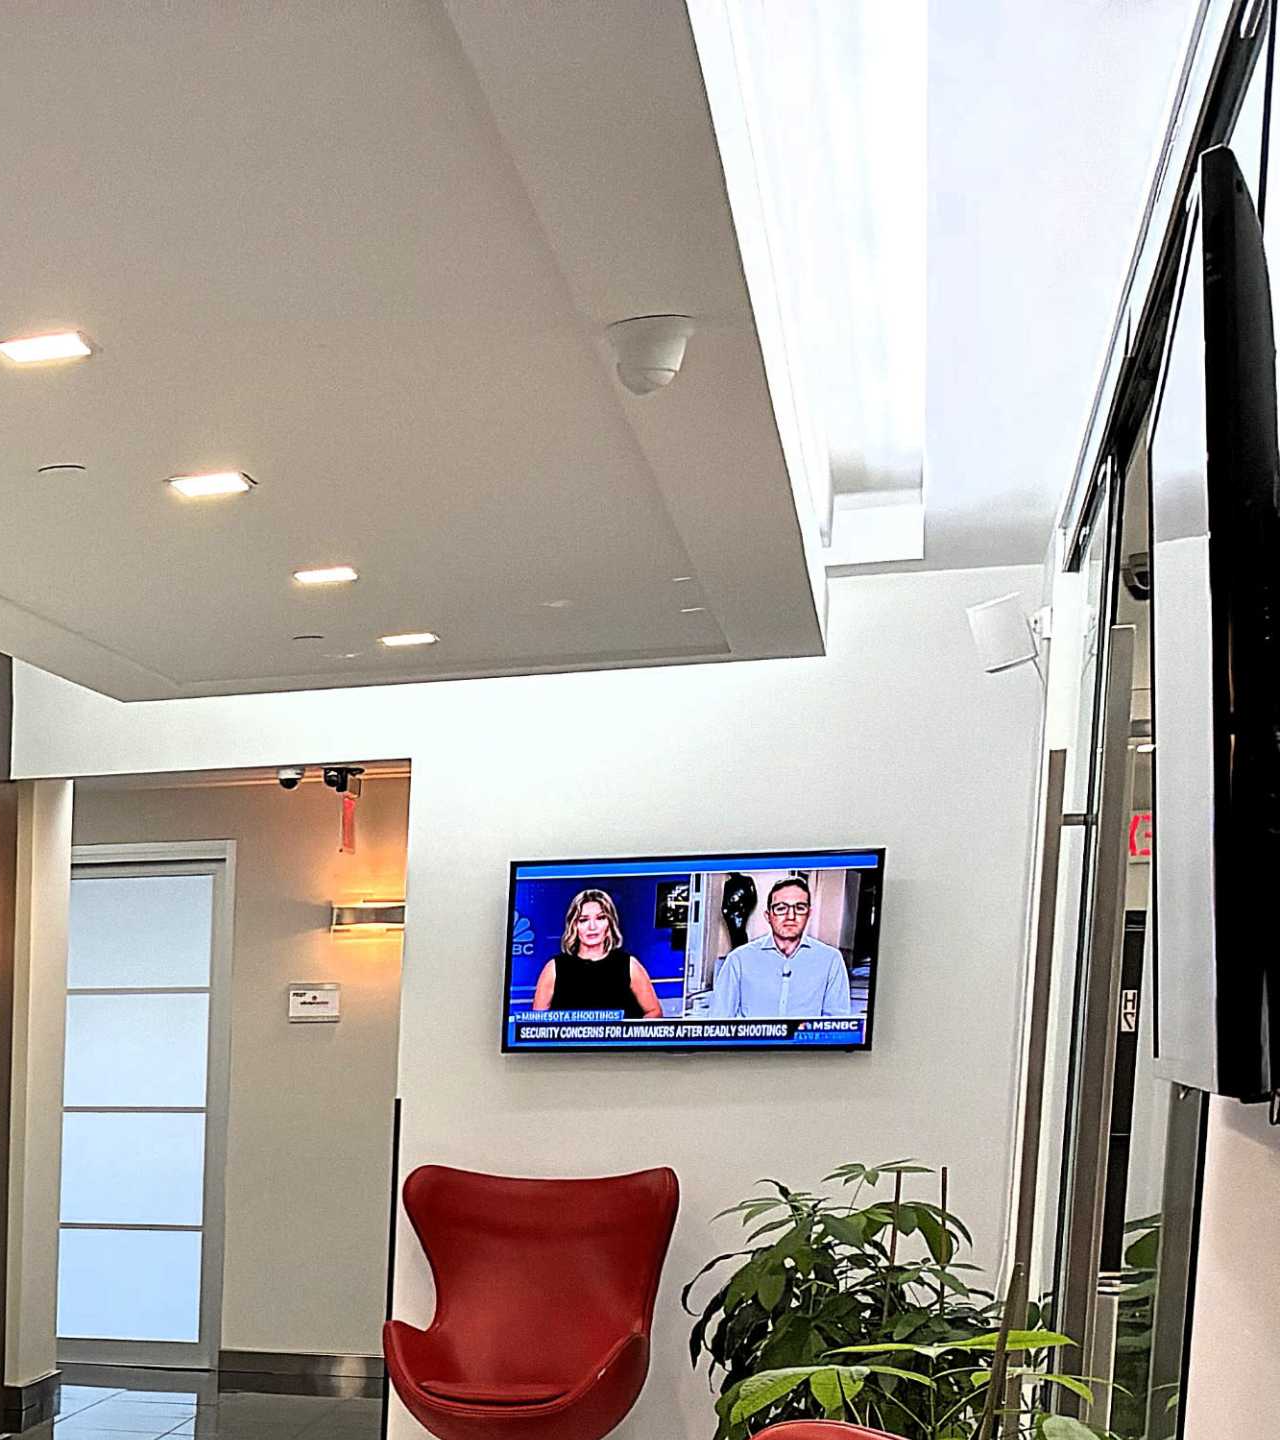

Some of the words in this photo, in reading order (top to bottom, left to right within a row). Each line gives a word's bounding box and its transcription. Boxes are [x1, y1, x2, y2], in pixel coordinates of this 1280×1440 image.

[512, 943, 534, 955] BC
[522, 1011, 569, 1021] MINNESOTA
[571, 1010, 619, 1020] SHOOTINGS
[813, 1021, 858, 1030] MSNBC
[520, 1026, 559, 1039] SECURITY
[560, 1026, 604, 1039] CONCERNS
[605, 1026, 622, 1038] FOR
[623, 1025, 675, 1038] LAWMAKERS
[676, 1025, 702, 1038] AFTER
[703, 1024, 737, 1037] DEADLY
[738, 1024, 788, 1037] SHOOTINGS
